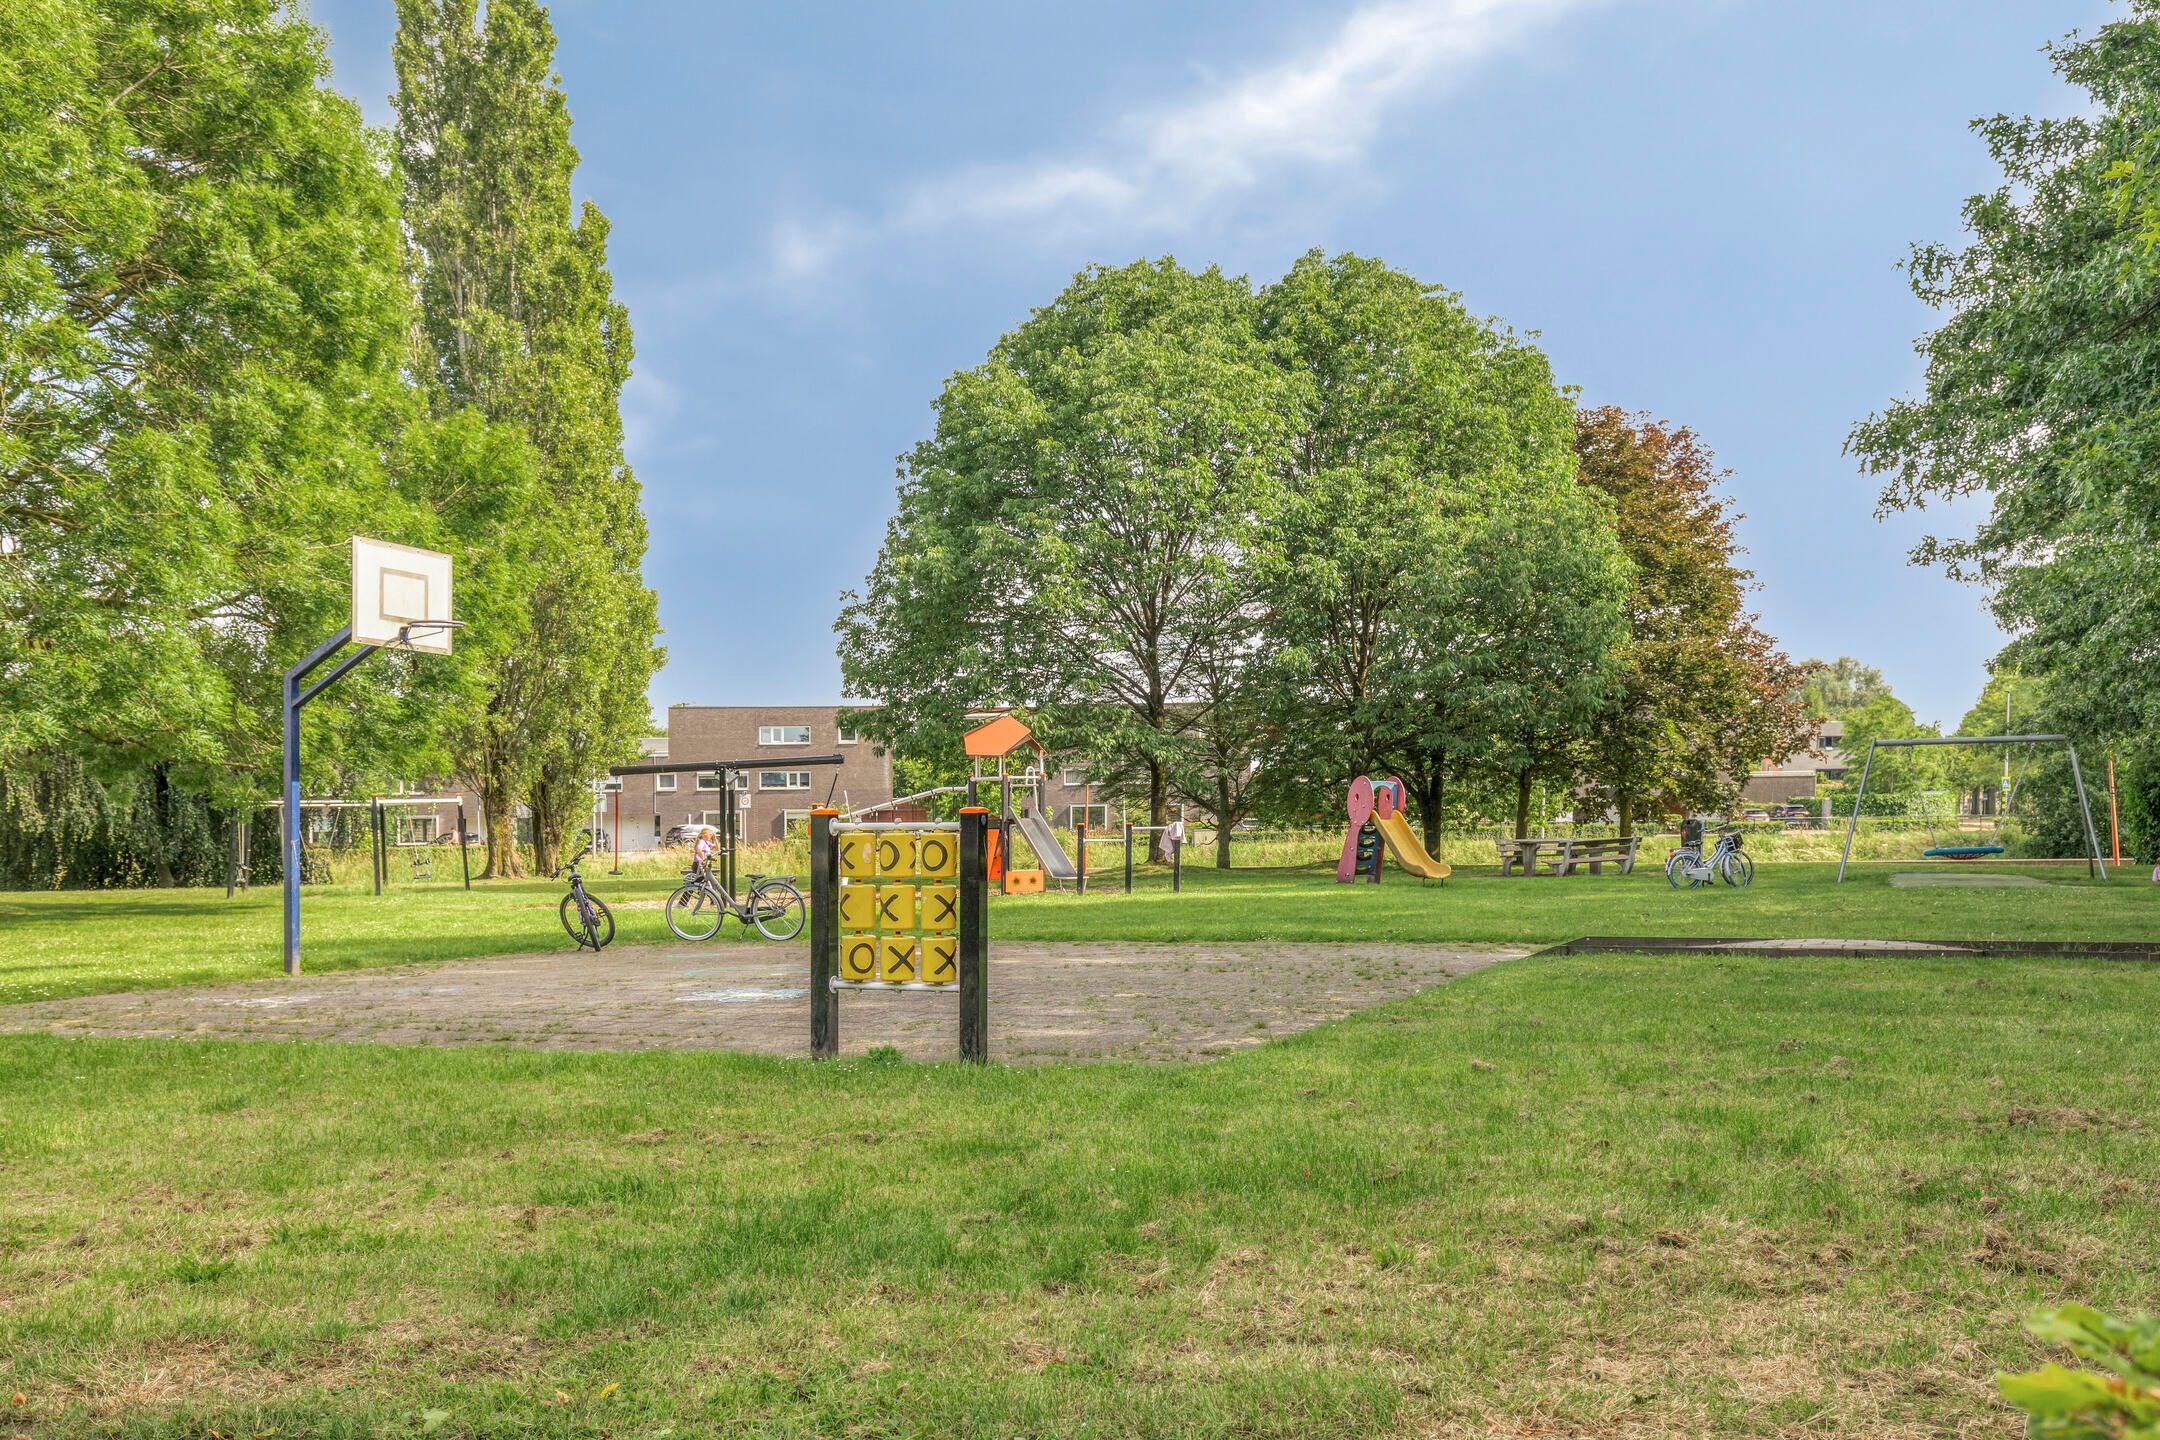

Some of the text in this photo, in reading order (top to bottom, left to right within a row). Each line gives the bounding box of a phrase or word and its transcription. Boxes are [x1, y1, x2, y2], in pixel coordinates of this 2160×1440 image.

[922, 840, 948, 871] O
[934, 894, 957, 922] X
[849, 943, 957, 975] O X X
